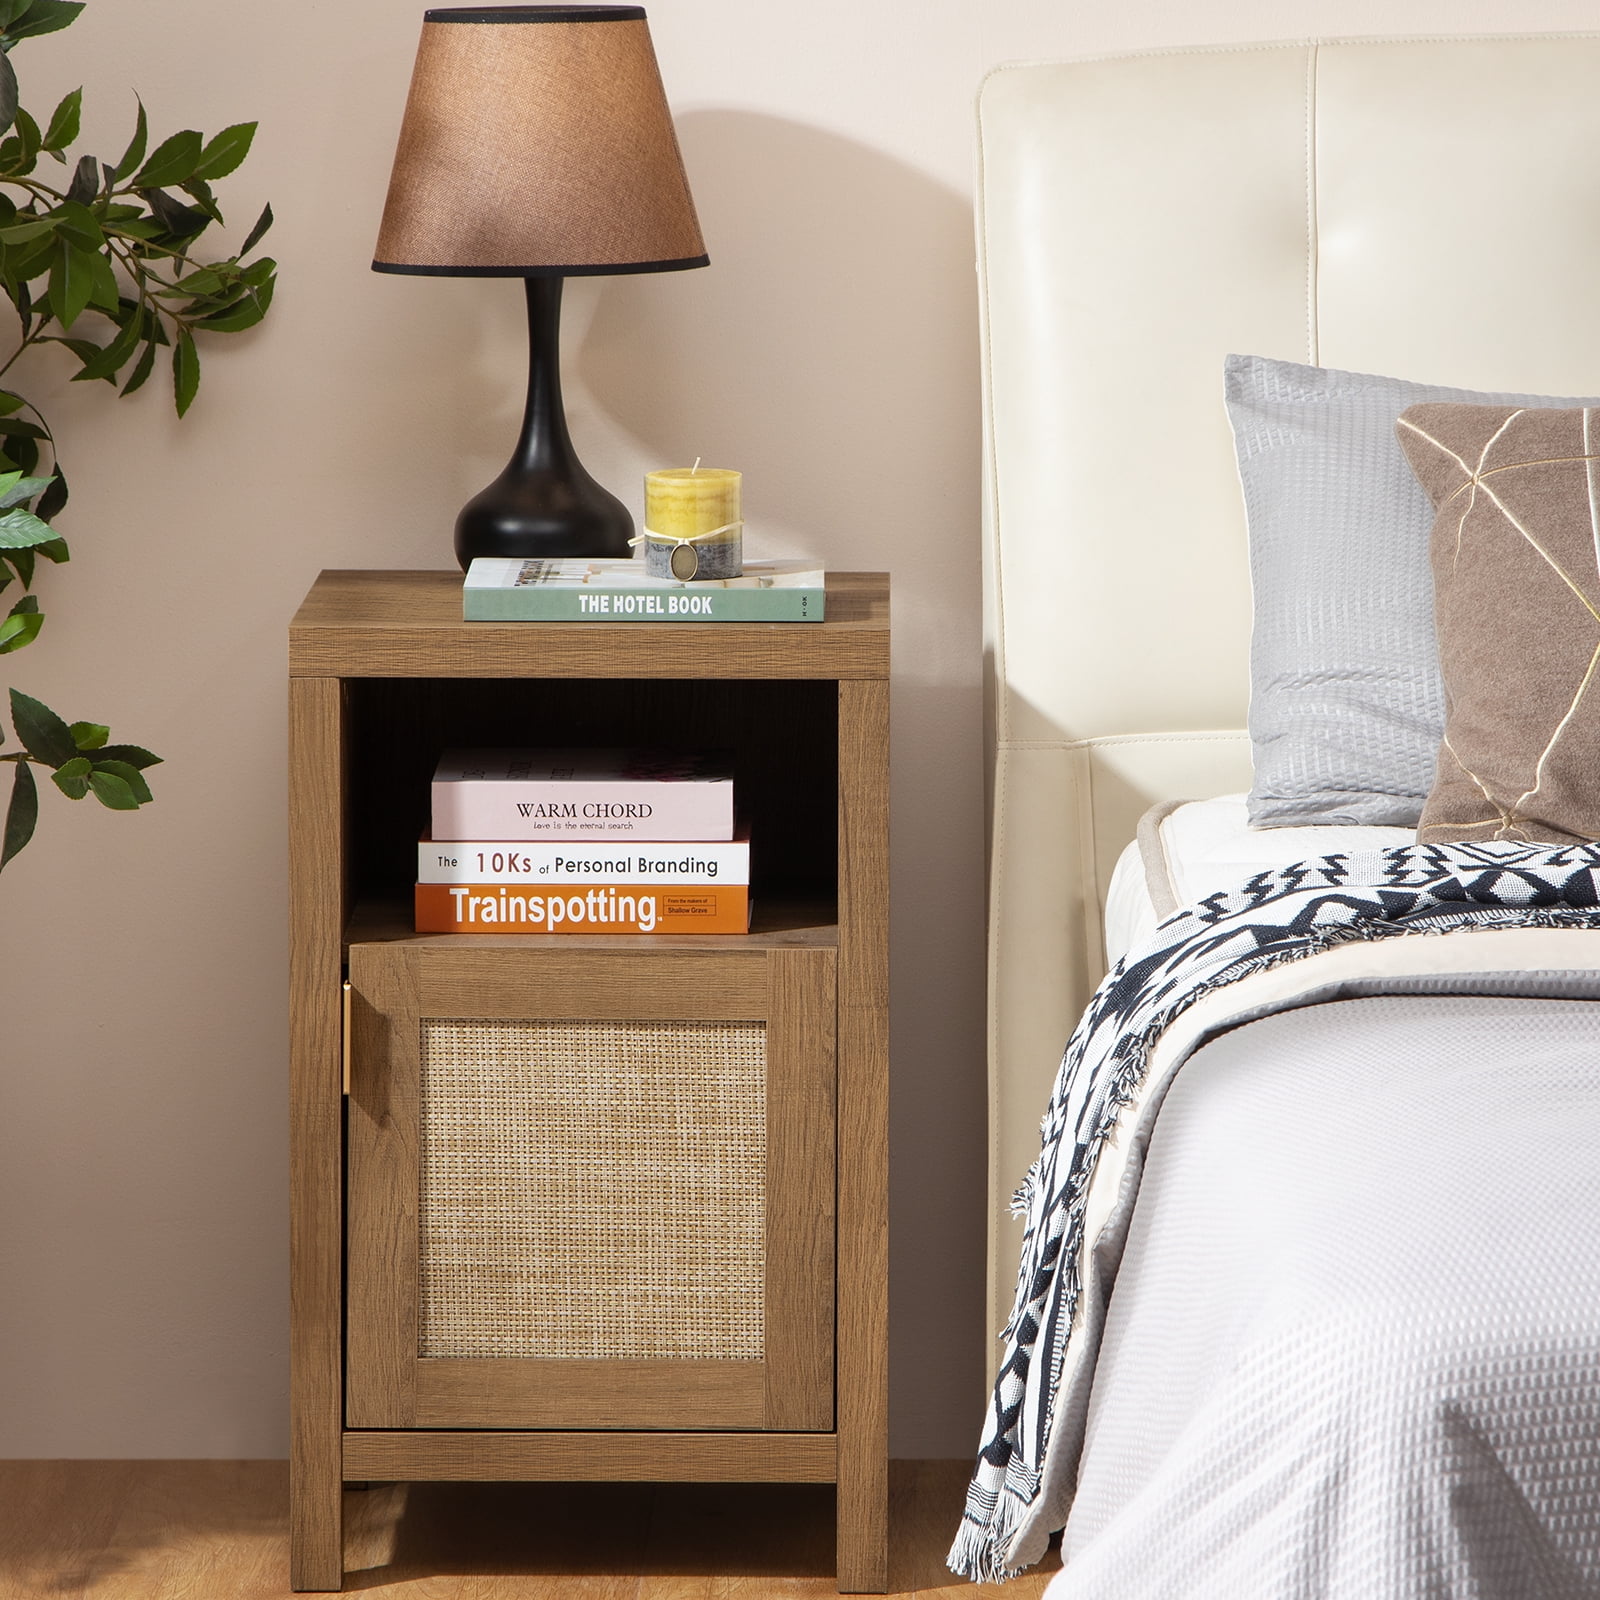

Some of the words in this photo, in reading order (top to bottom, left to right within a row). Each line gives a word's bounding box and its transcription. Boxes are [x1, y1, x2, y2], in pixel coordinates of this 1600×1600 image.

[579, 594, 610, 614] THE
[614, 594, 665, 615] HOTEL
[668, 595, 713, 615] BOOK
[516, 803, 577, 818] WARM
[583, 803, 653, 818] CHORD
[533, 821, 551, 830] Love
[553, 821, 562, 830] is
[565, 821, 577, 830] the
[580, 821, 605, 830] eternal
[608, 821, 633, 830] search
[438, 855, 458, 868] The
[477, 852, 532, 873] 10Ks
[539, 864, 550, 874] of
[555, 857, 632, 873] Personal
[638, 857, 719, 877] Branding
[449, 887, 656, 932] Trainspotting
